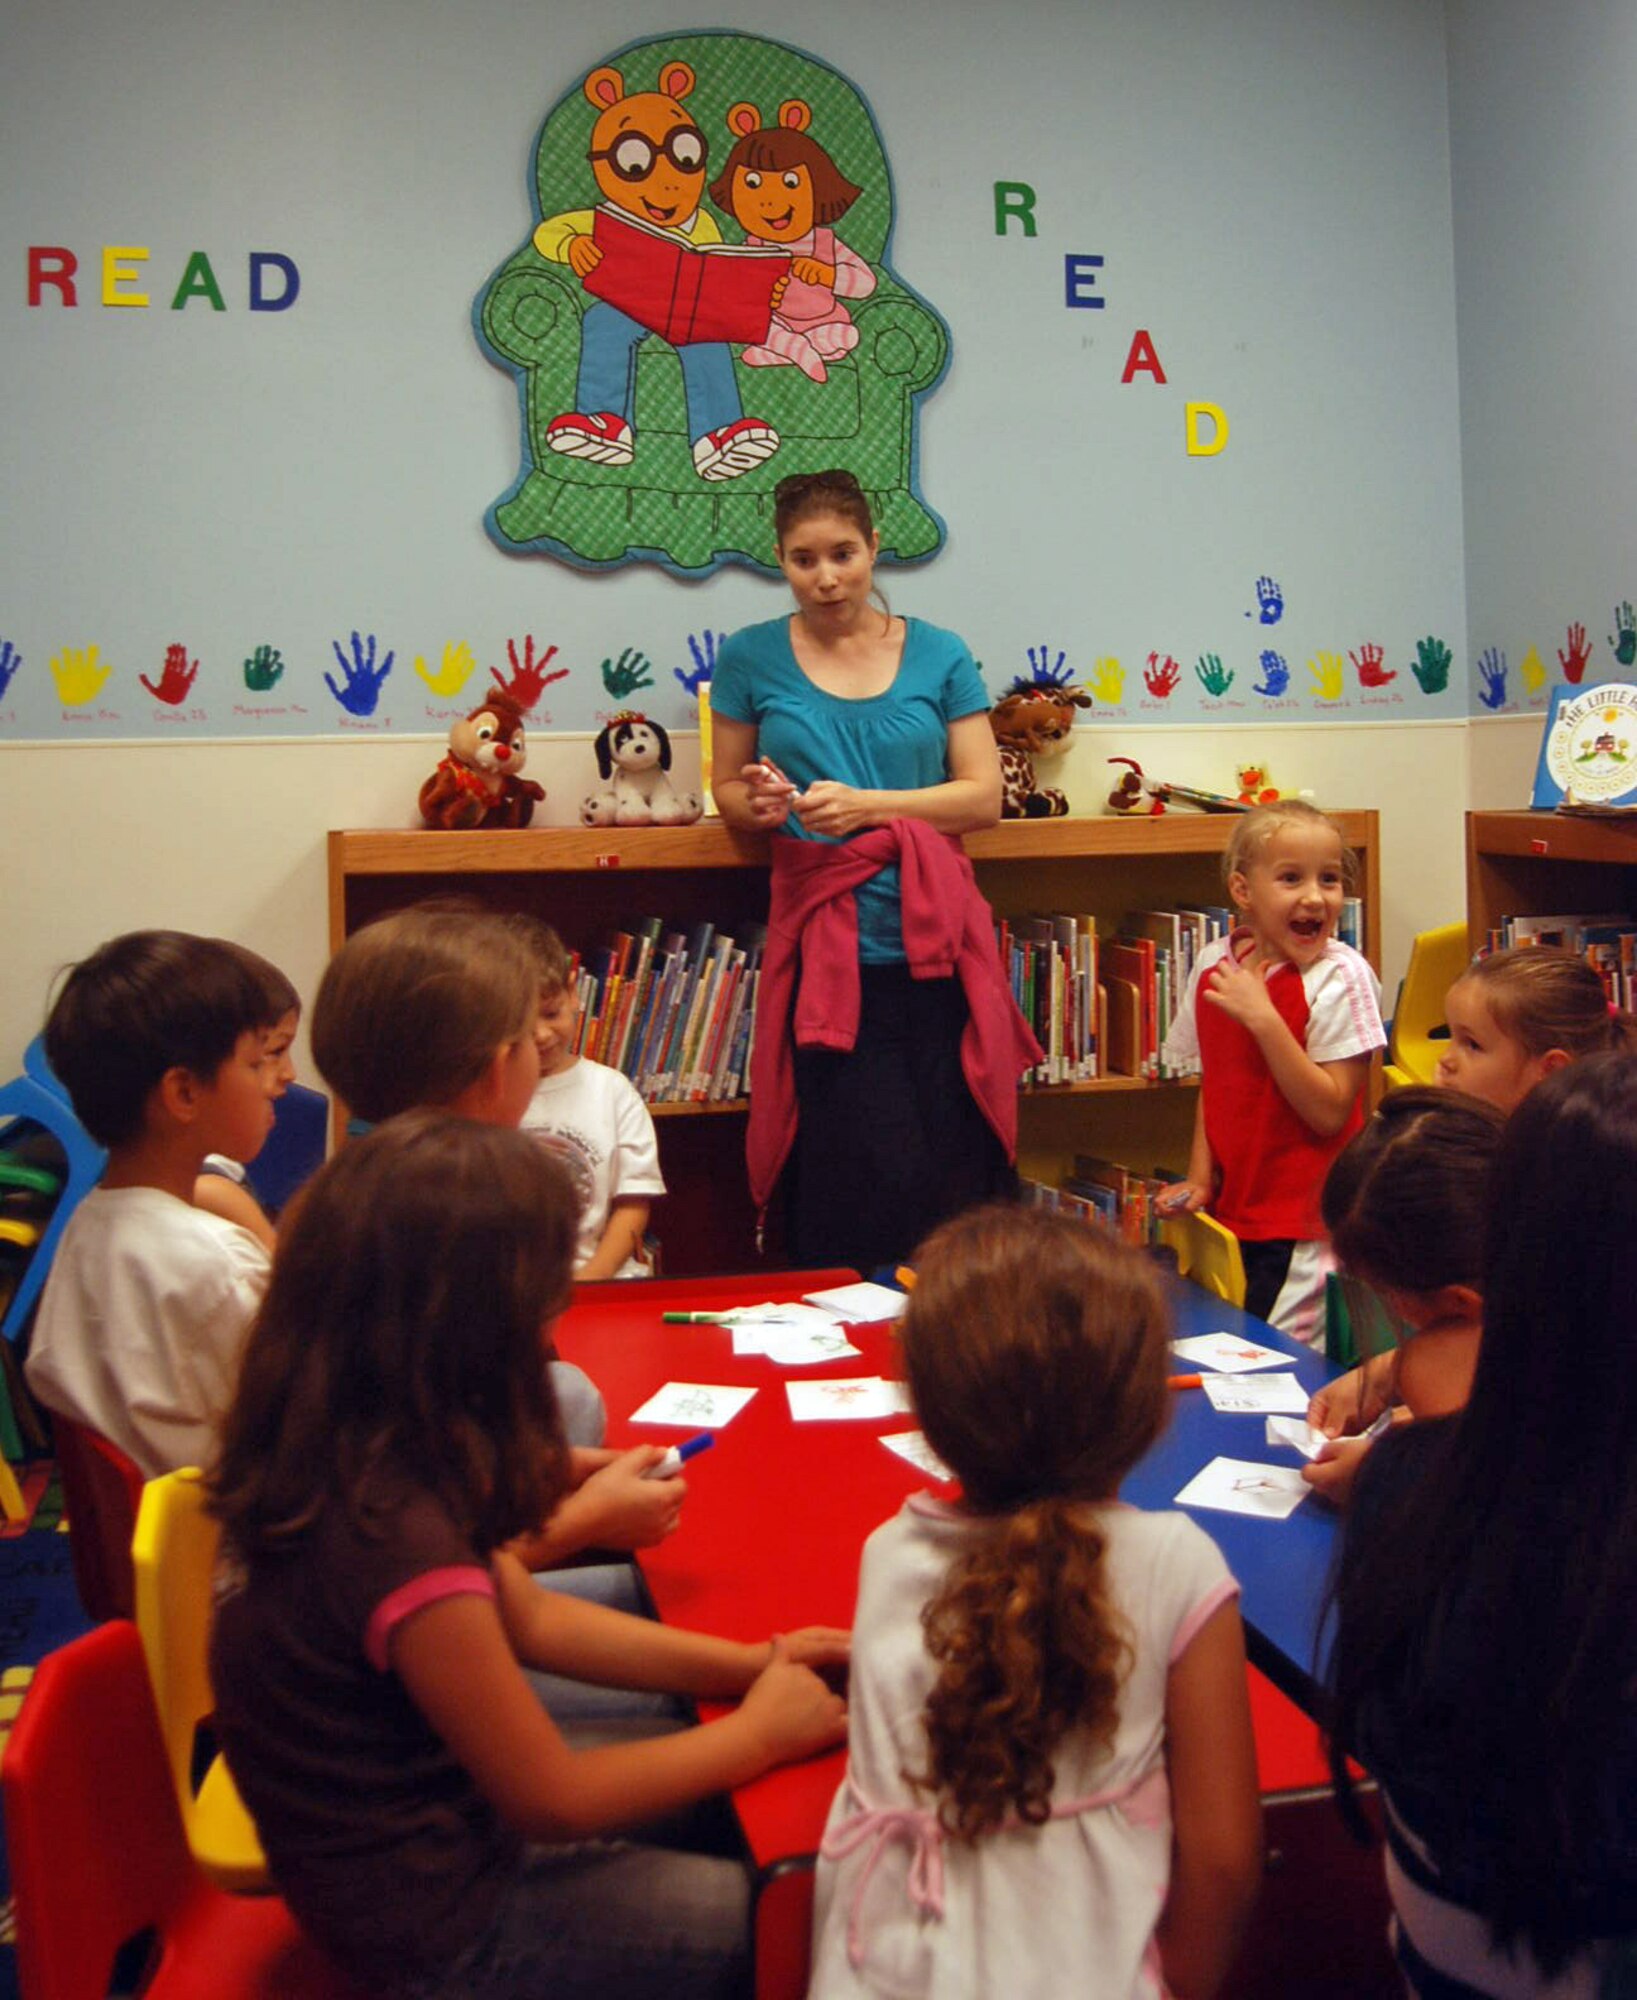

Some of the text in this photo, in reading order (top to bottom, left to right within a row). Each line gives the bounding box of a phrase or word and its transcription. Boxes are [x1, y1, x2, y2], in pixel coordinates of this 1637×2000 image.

[27, 246, 301, 312] READ
[993, 181, 1230, 457] READ
[1565, 704, 1584, 728] THE
[1587, 690, 1628, 709] LITTLE
